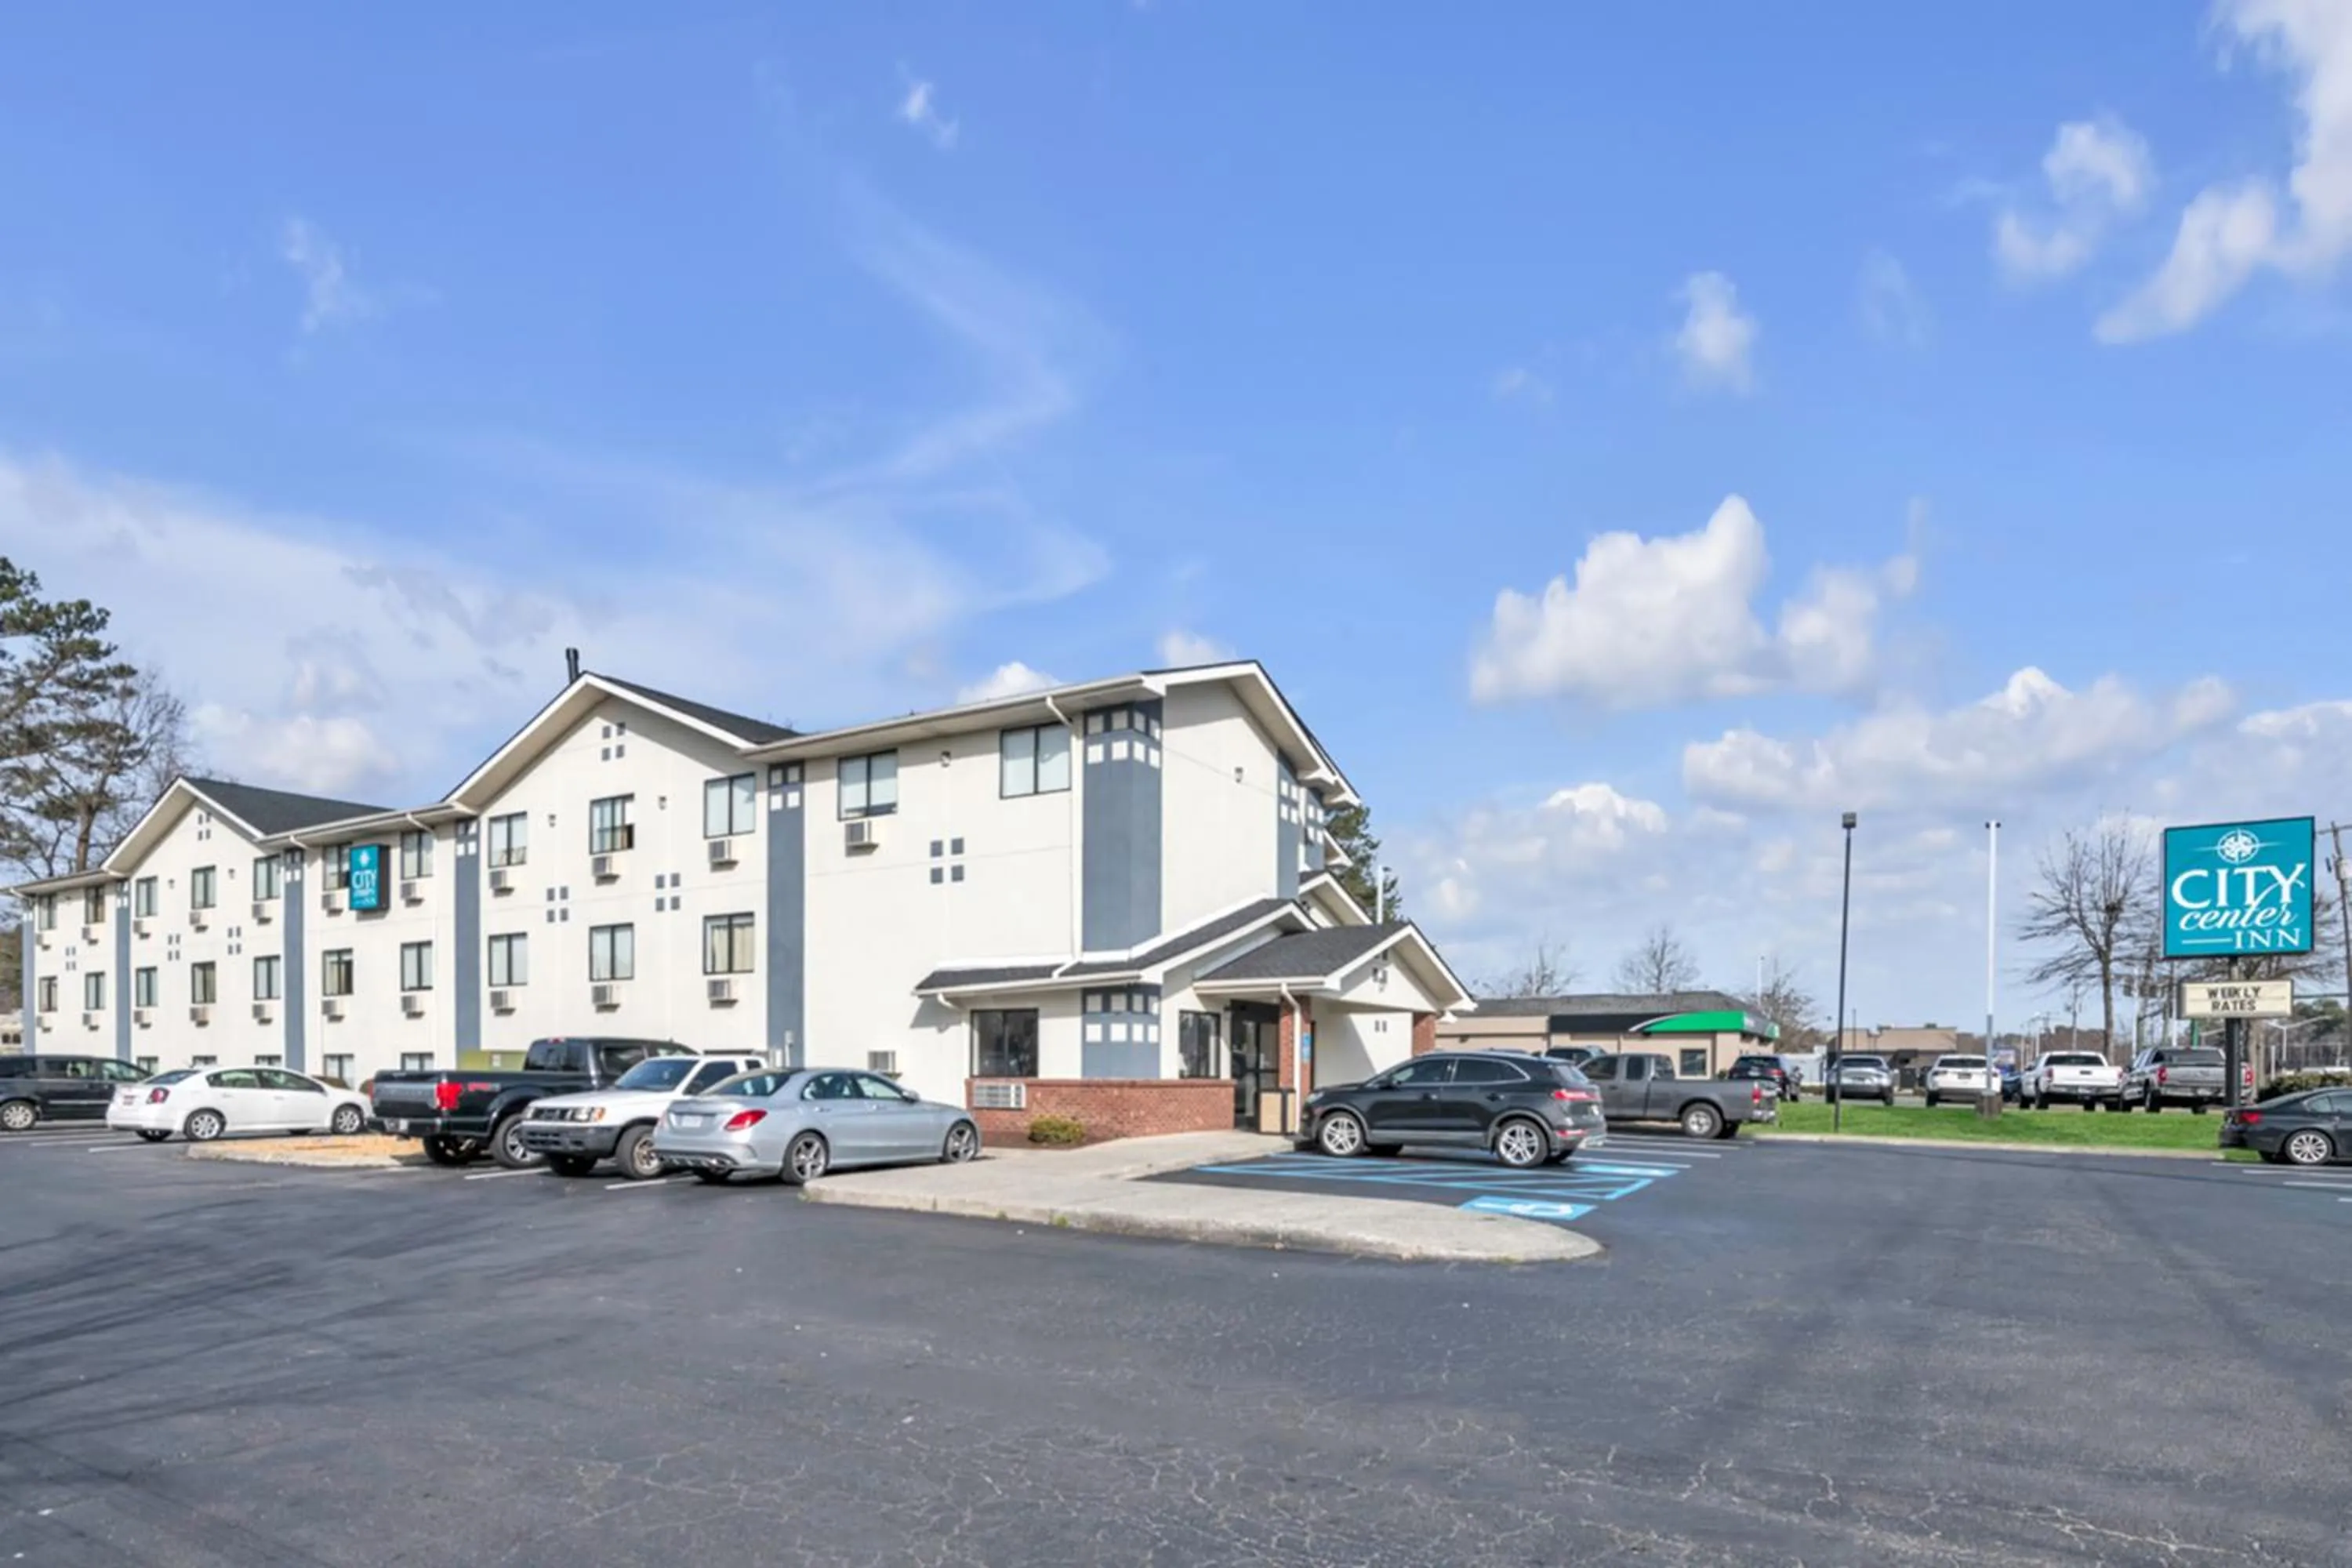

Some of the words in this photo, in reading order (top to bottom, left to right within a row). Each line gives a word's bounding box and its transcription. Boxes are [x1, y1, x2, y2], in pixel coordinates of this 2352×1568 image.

[2172, 863, 2306, 909] CITY
[2180, 882, 2304, 931] center
[2235, 928, 2301, 949] INN
[2211, 1000, 2256, 1011] RATES
